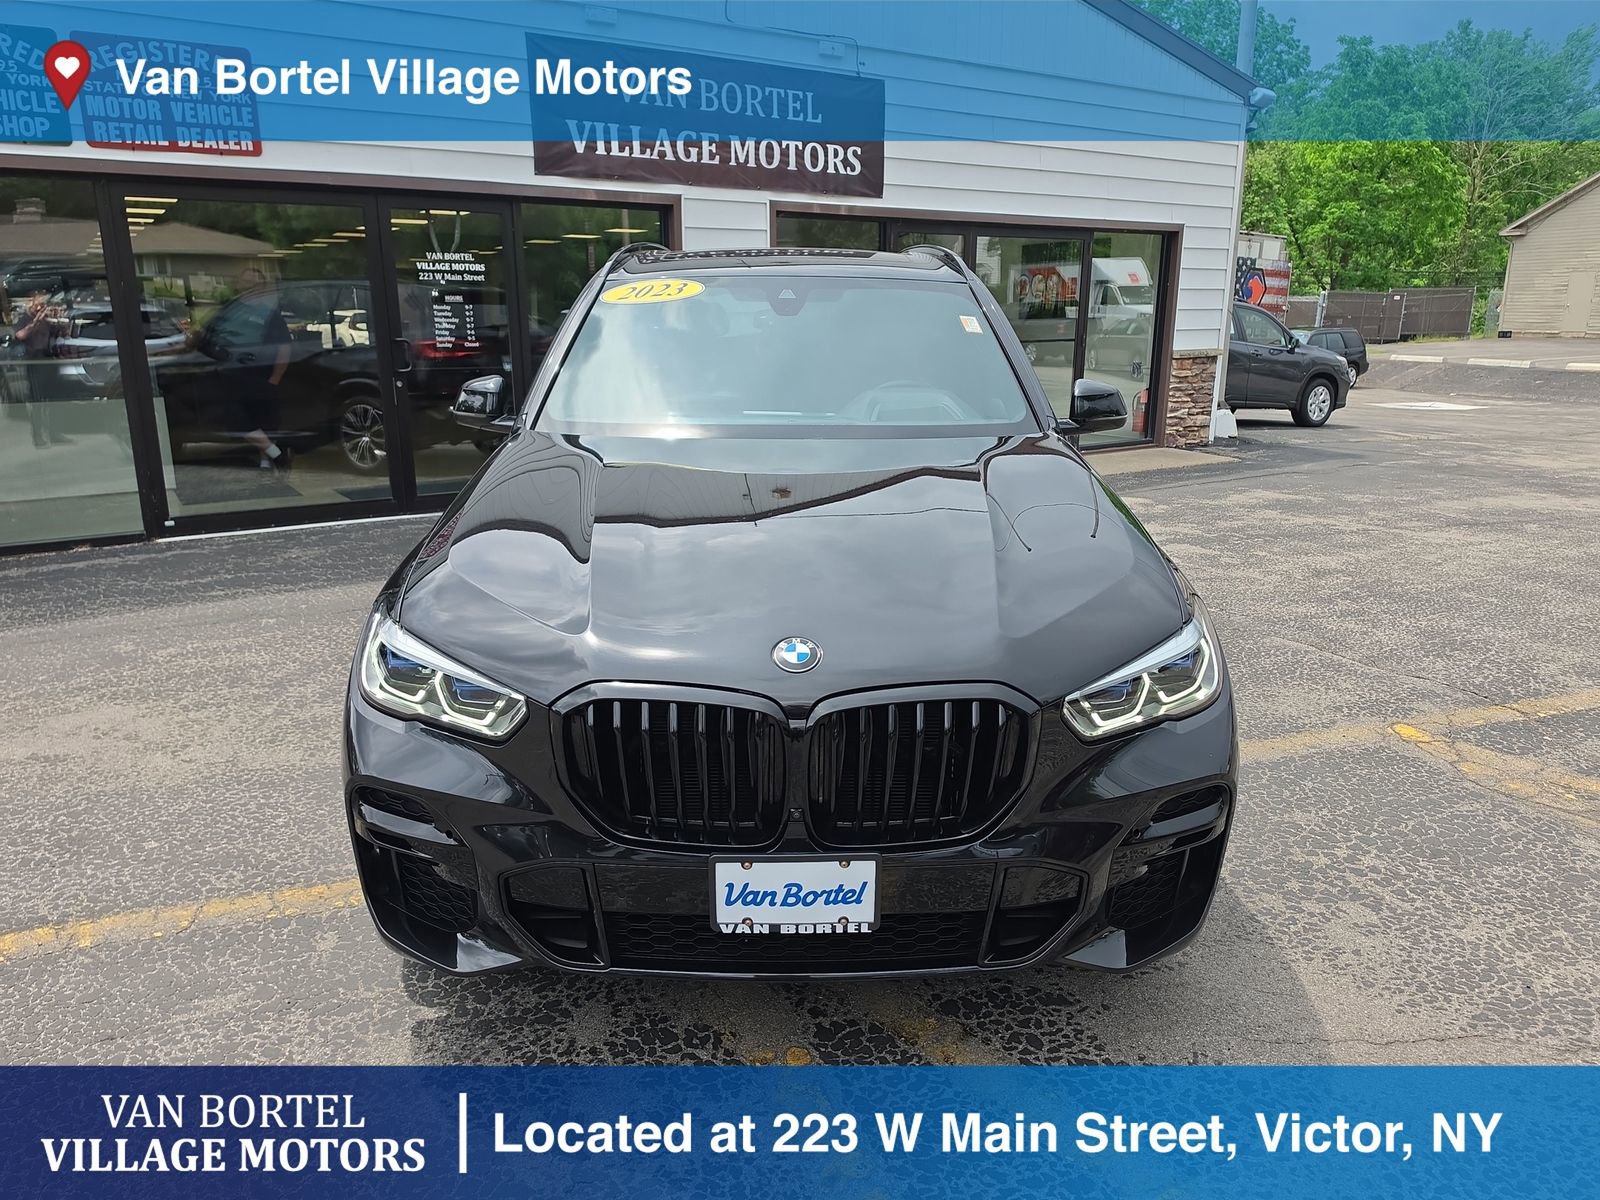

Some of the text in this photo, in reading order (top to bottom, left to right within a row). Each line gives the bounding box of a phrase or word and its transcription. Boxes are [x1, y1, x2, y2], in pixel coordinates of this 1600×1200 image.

[88, 40, 245, 74] REGISTER
[84, 80, 130, 95] STAT
[85, 94, 254, 128] MOTOR VEHICLE
[699, 78, 822, 124] BORTEL
[0, 114, 50, 138] HOP
[92, 120, 254, 151] RETAIL DEALER
[565, 119, 862, 176] VILLAGE MOTORS
[416, 261, 486, 271] VILLAGE MOTORS
[426, 252, 475, 261] VAN BORTEL
[418, 272, 486, 281] 223 W Main Street
[616, 282, 690, 301] 2023
[724, 880, 869, 908] Van Bortel
[719, 922, 873, 935] VAN BORTEL
